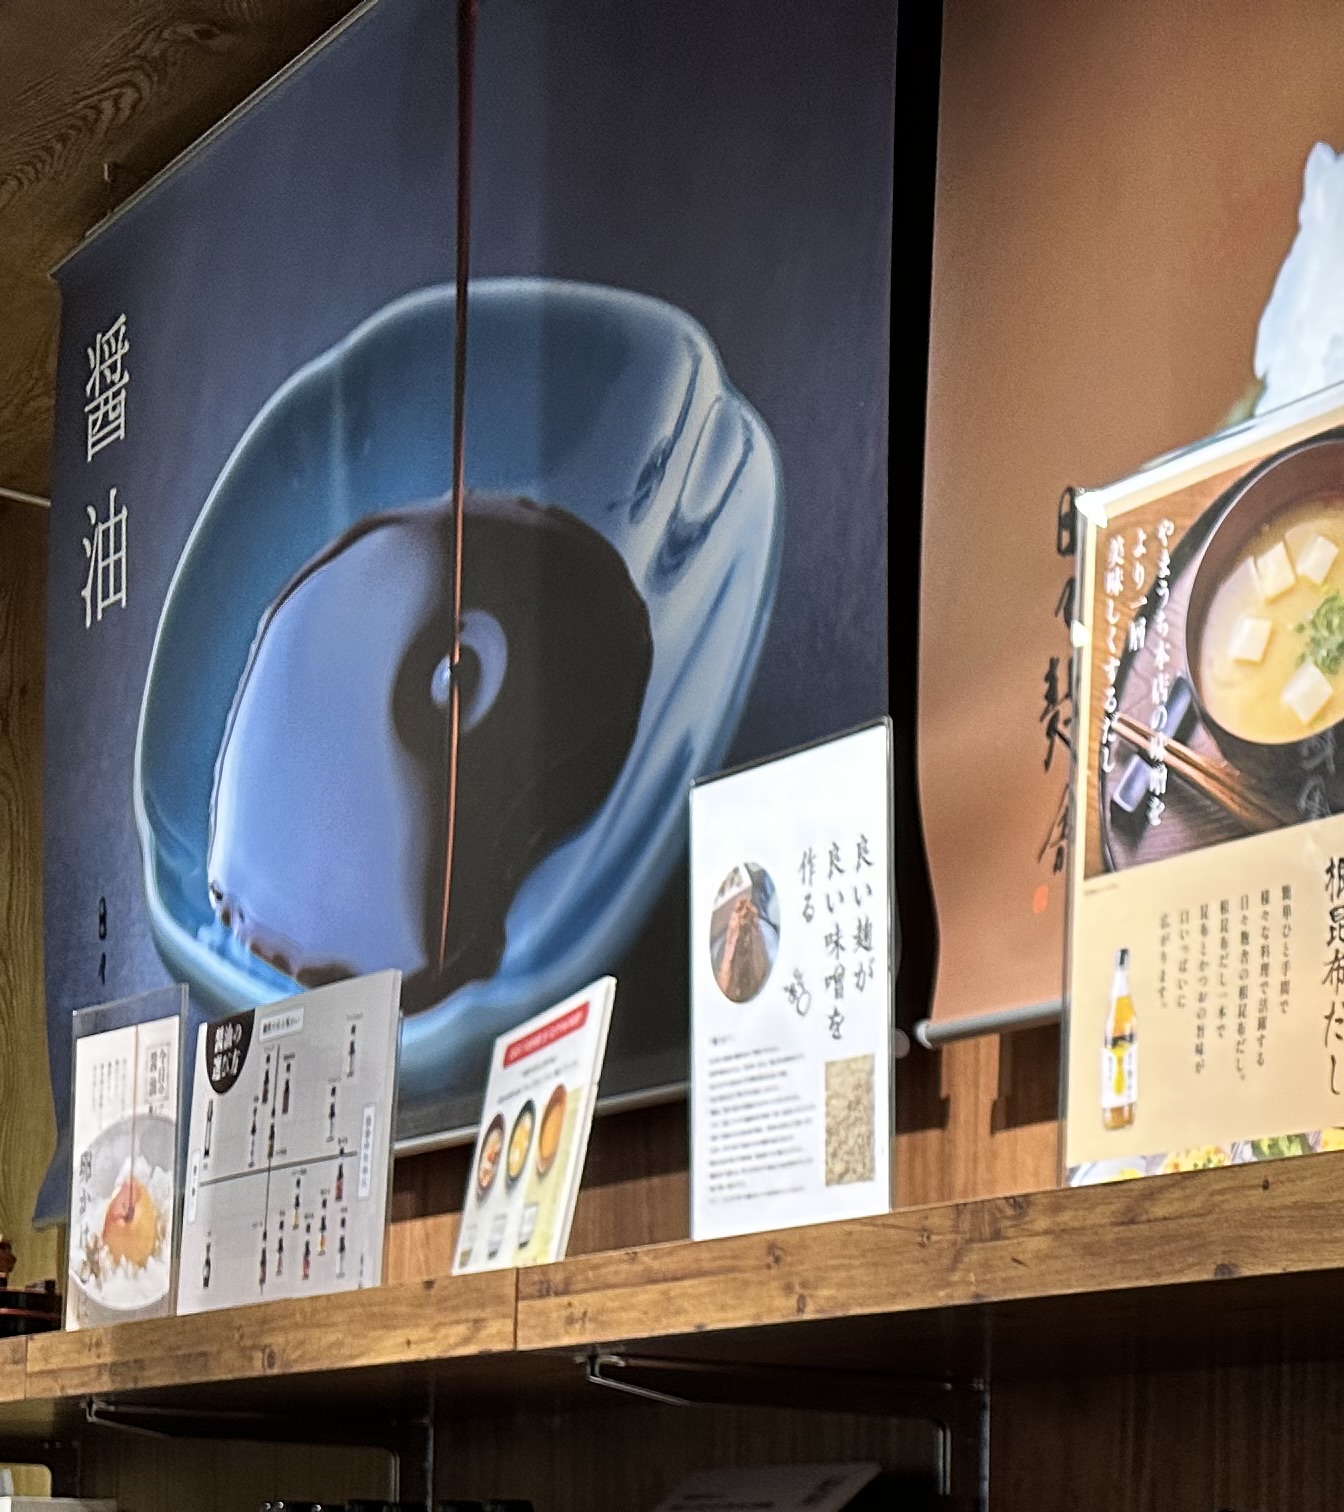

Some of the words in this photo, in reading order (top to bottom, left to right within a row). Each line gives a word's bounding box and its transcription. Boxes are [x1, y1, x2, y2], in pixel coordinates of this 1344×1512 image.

[80, 314, 130, 628] 醤油
[798, 845, 817, 924] 作る
[823, 841, 847, 1041] 良い味噌を
